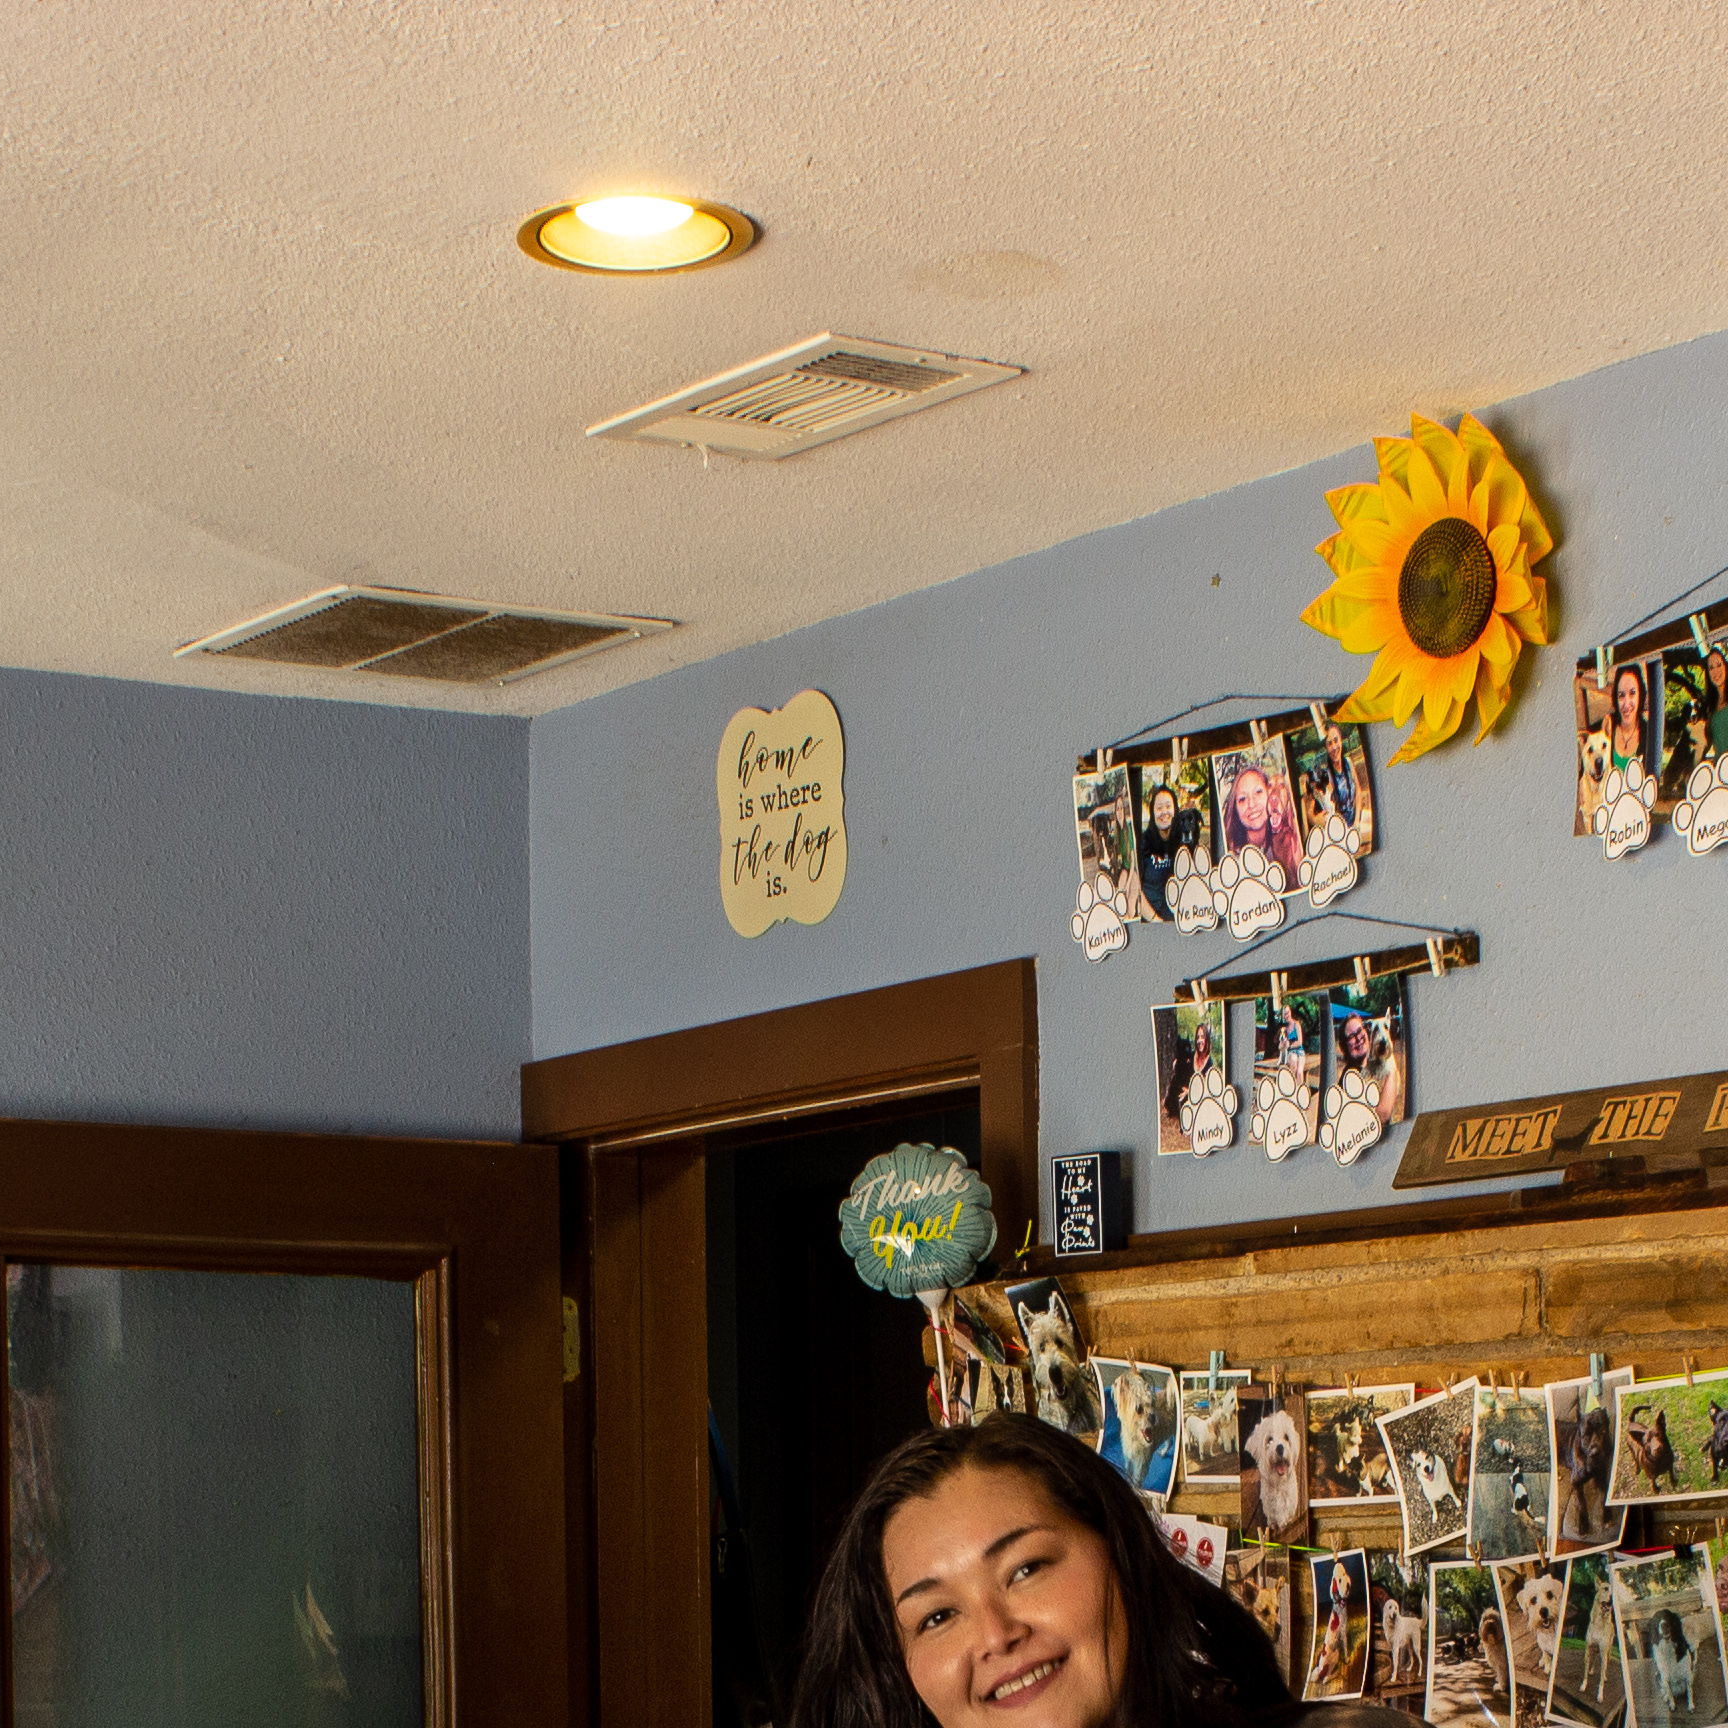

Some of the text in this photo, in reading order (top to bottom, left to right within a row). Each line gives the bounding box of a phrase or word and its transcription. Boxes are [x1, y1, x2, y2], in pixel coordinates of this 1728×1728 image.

[738, 730, 823, 788] home
[739, 781, 822, 821] is where
[1609, 820, 1644, 847] Robin
[732, 812, 838, 885] the dog
[766, 870, 787, 897] is.
[1313, 864, 1352, 894] Rachael
[1178, 908, 1190, 921] Ye
[1233, 900, 1278, 926] Jordan
[1088, 926, 1122, 950] Kaitlyn
[1197, 1124, 1224, 1143] Mindy
[1274, 1121, 1299, 1145] Lyzz
[1338, 1120, 1378, 1158] Melanie
[1448, 1109, 1558, 1160] MEET
[1601, 1096, 1677, 1141] THE
[852, 1161, 970, 1221] Thank
[1061, 1175, 1093, 1200] Heart
[869, 1200, 963, 1269] You!
